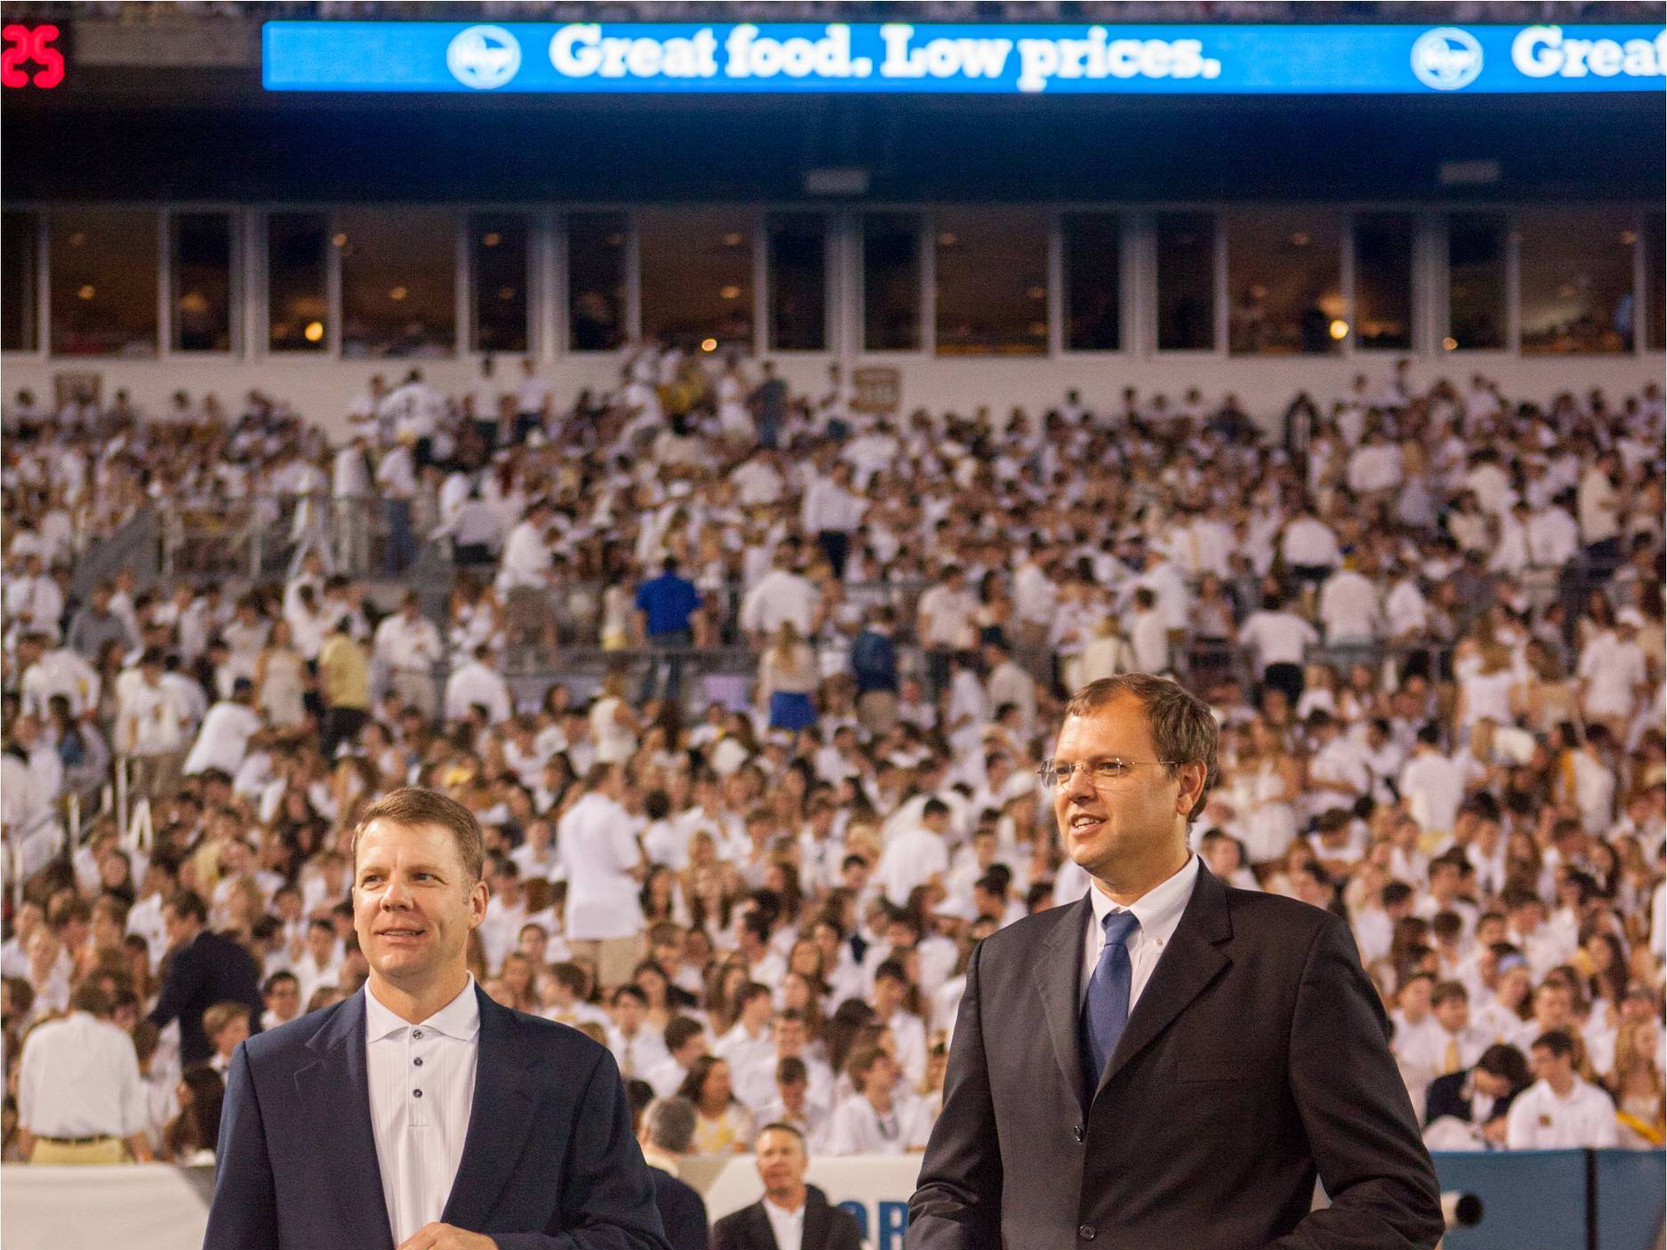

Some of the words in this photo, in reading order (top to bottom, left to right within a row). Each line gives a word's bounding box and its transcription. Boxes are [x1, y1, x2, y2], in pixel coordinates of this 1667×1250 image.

[1, 24, 65, 88] 25
[549, 23, 718, 78] Great
[724, 23, 873, 78] food.
[880, 23, 1013, 78] Low
[1017, 25, 1221, 92] prices.
